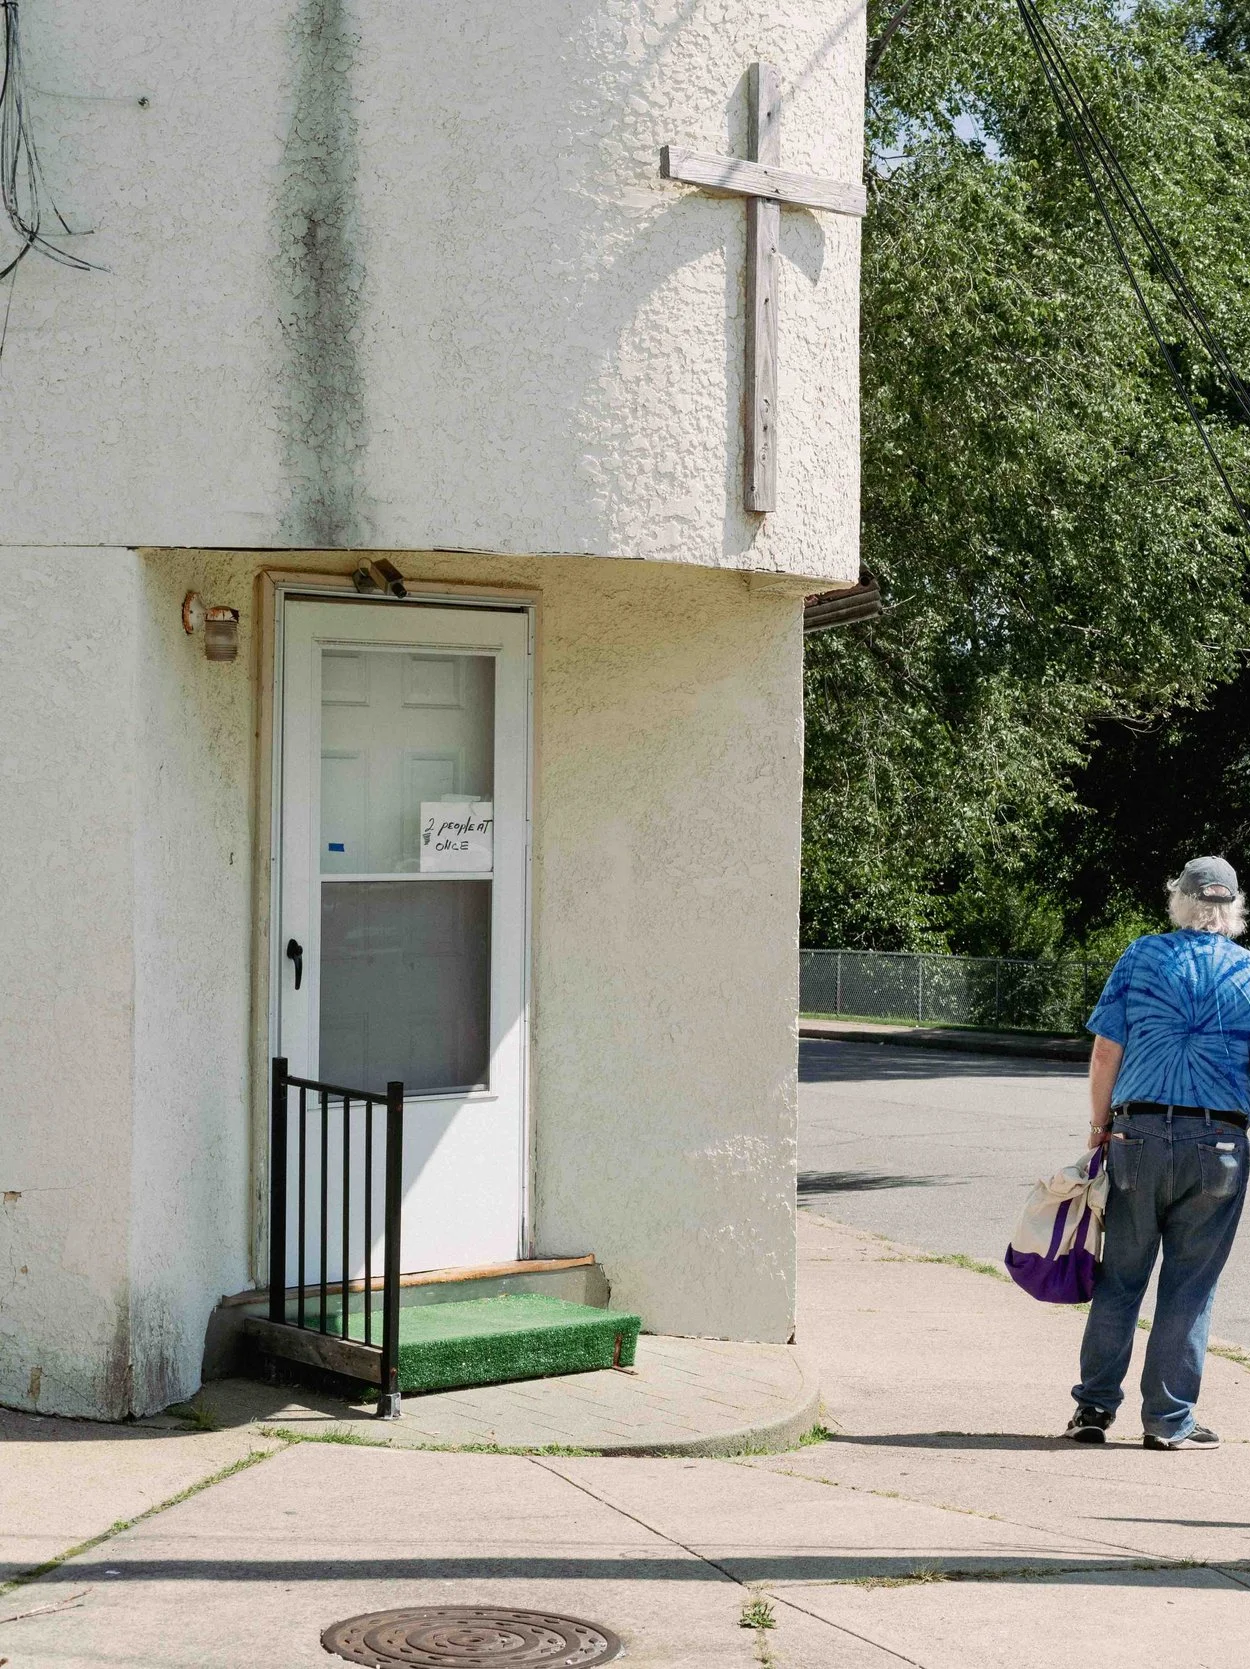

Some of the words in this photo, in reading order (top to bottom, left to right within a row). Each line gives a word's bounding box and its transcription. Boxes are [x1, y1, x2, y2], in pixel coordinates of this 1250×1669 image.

[424, 818, 434, 832] 2
[477, 819, 493, 834] AT
[436, 839, 469, 851] ONCE
